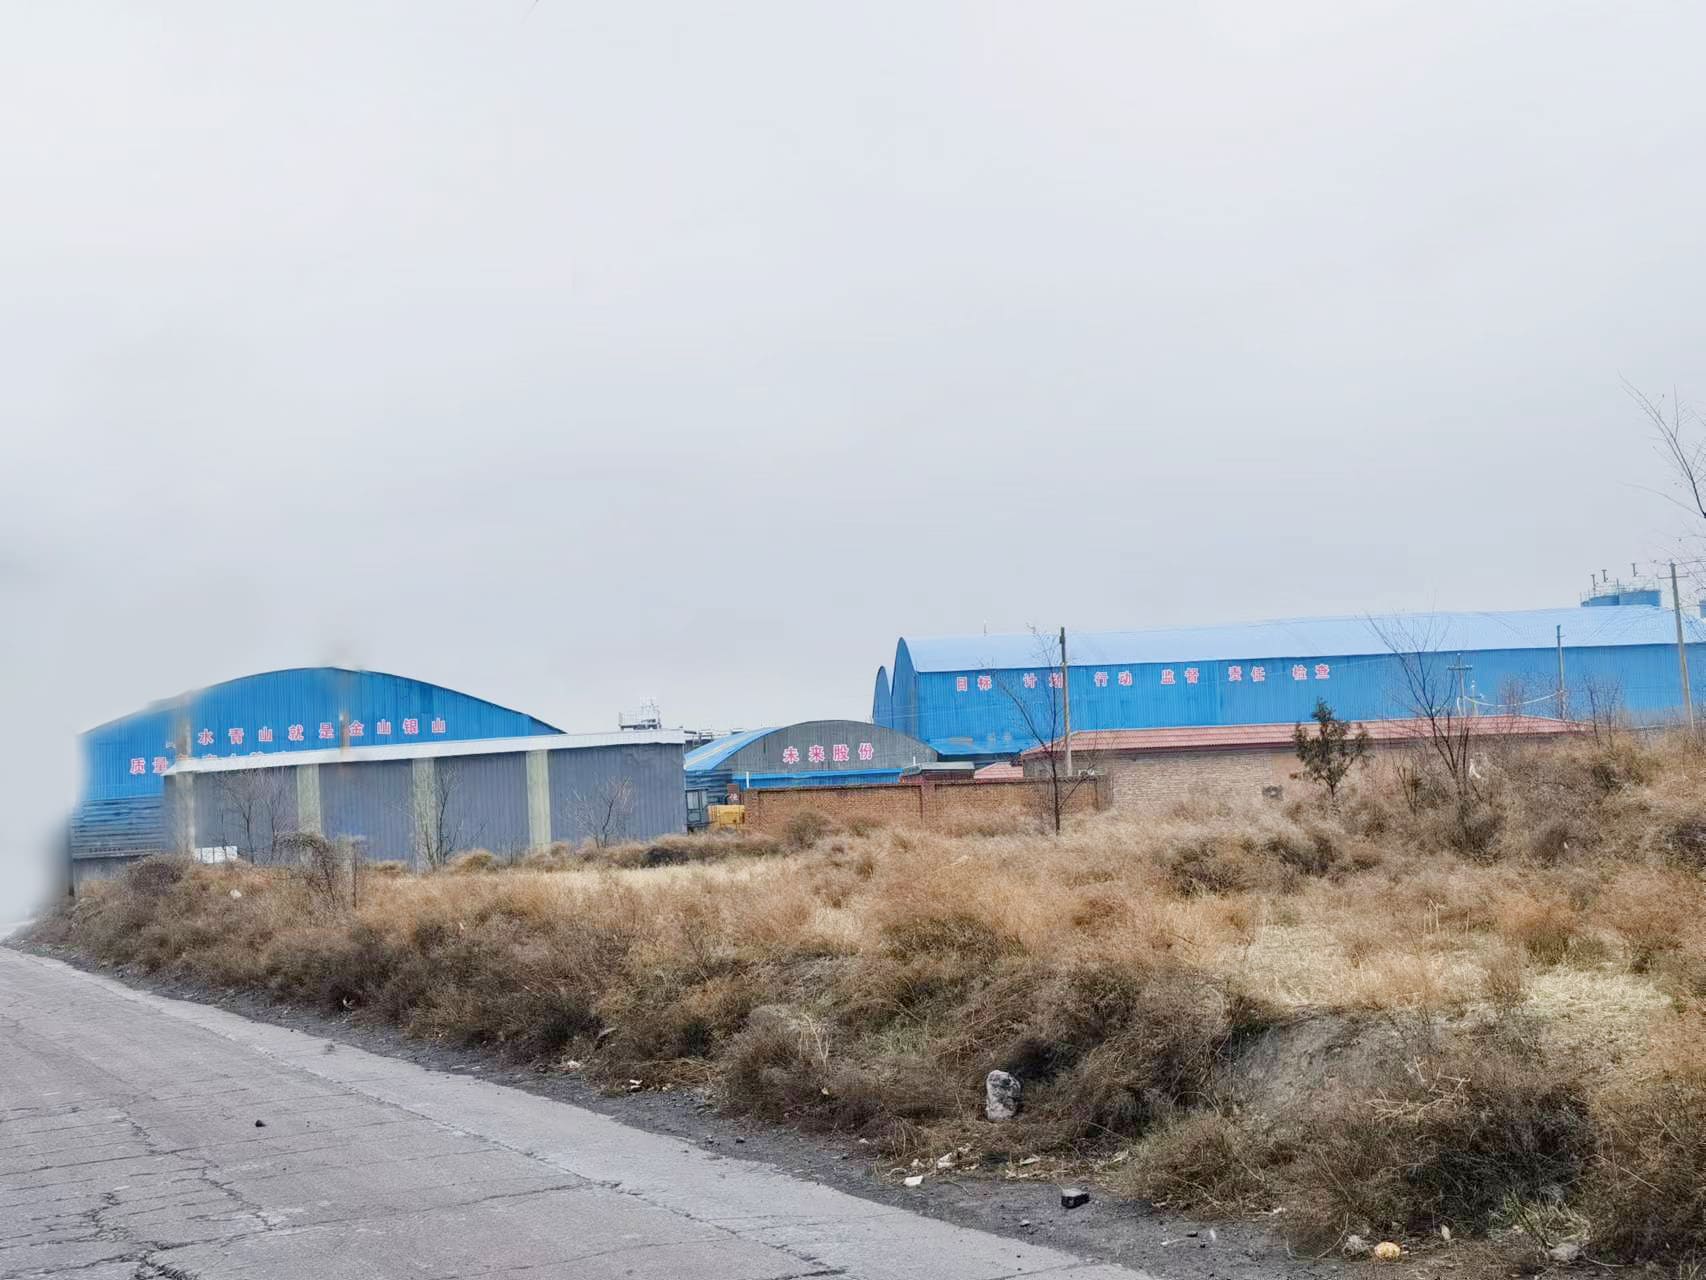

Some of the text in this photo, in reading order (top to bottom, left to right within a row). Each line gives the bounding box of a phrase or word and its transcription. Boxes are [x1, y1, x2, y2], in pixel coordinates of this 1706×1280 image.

[956, 663, 1330, 692] 目标 计划 行动 监督 责任 检查
[165, 717, 446, 750] 水青山就是金山银山
[782, 742, 874, 764] 未来股份
